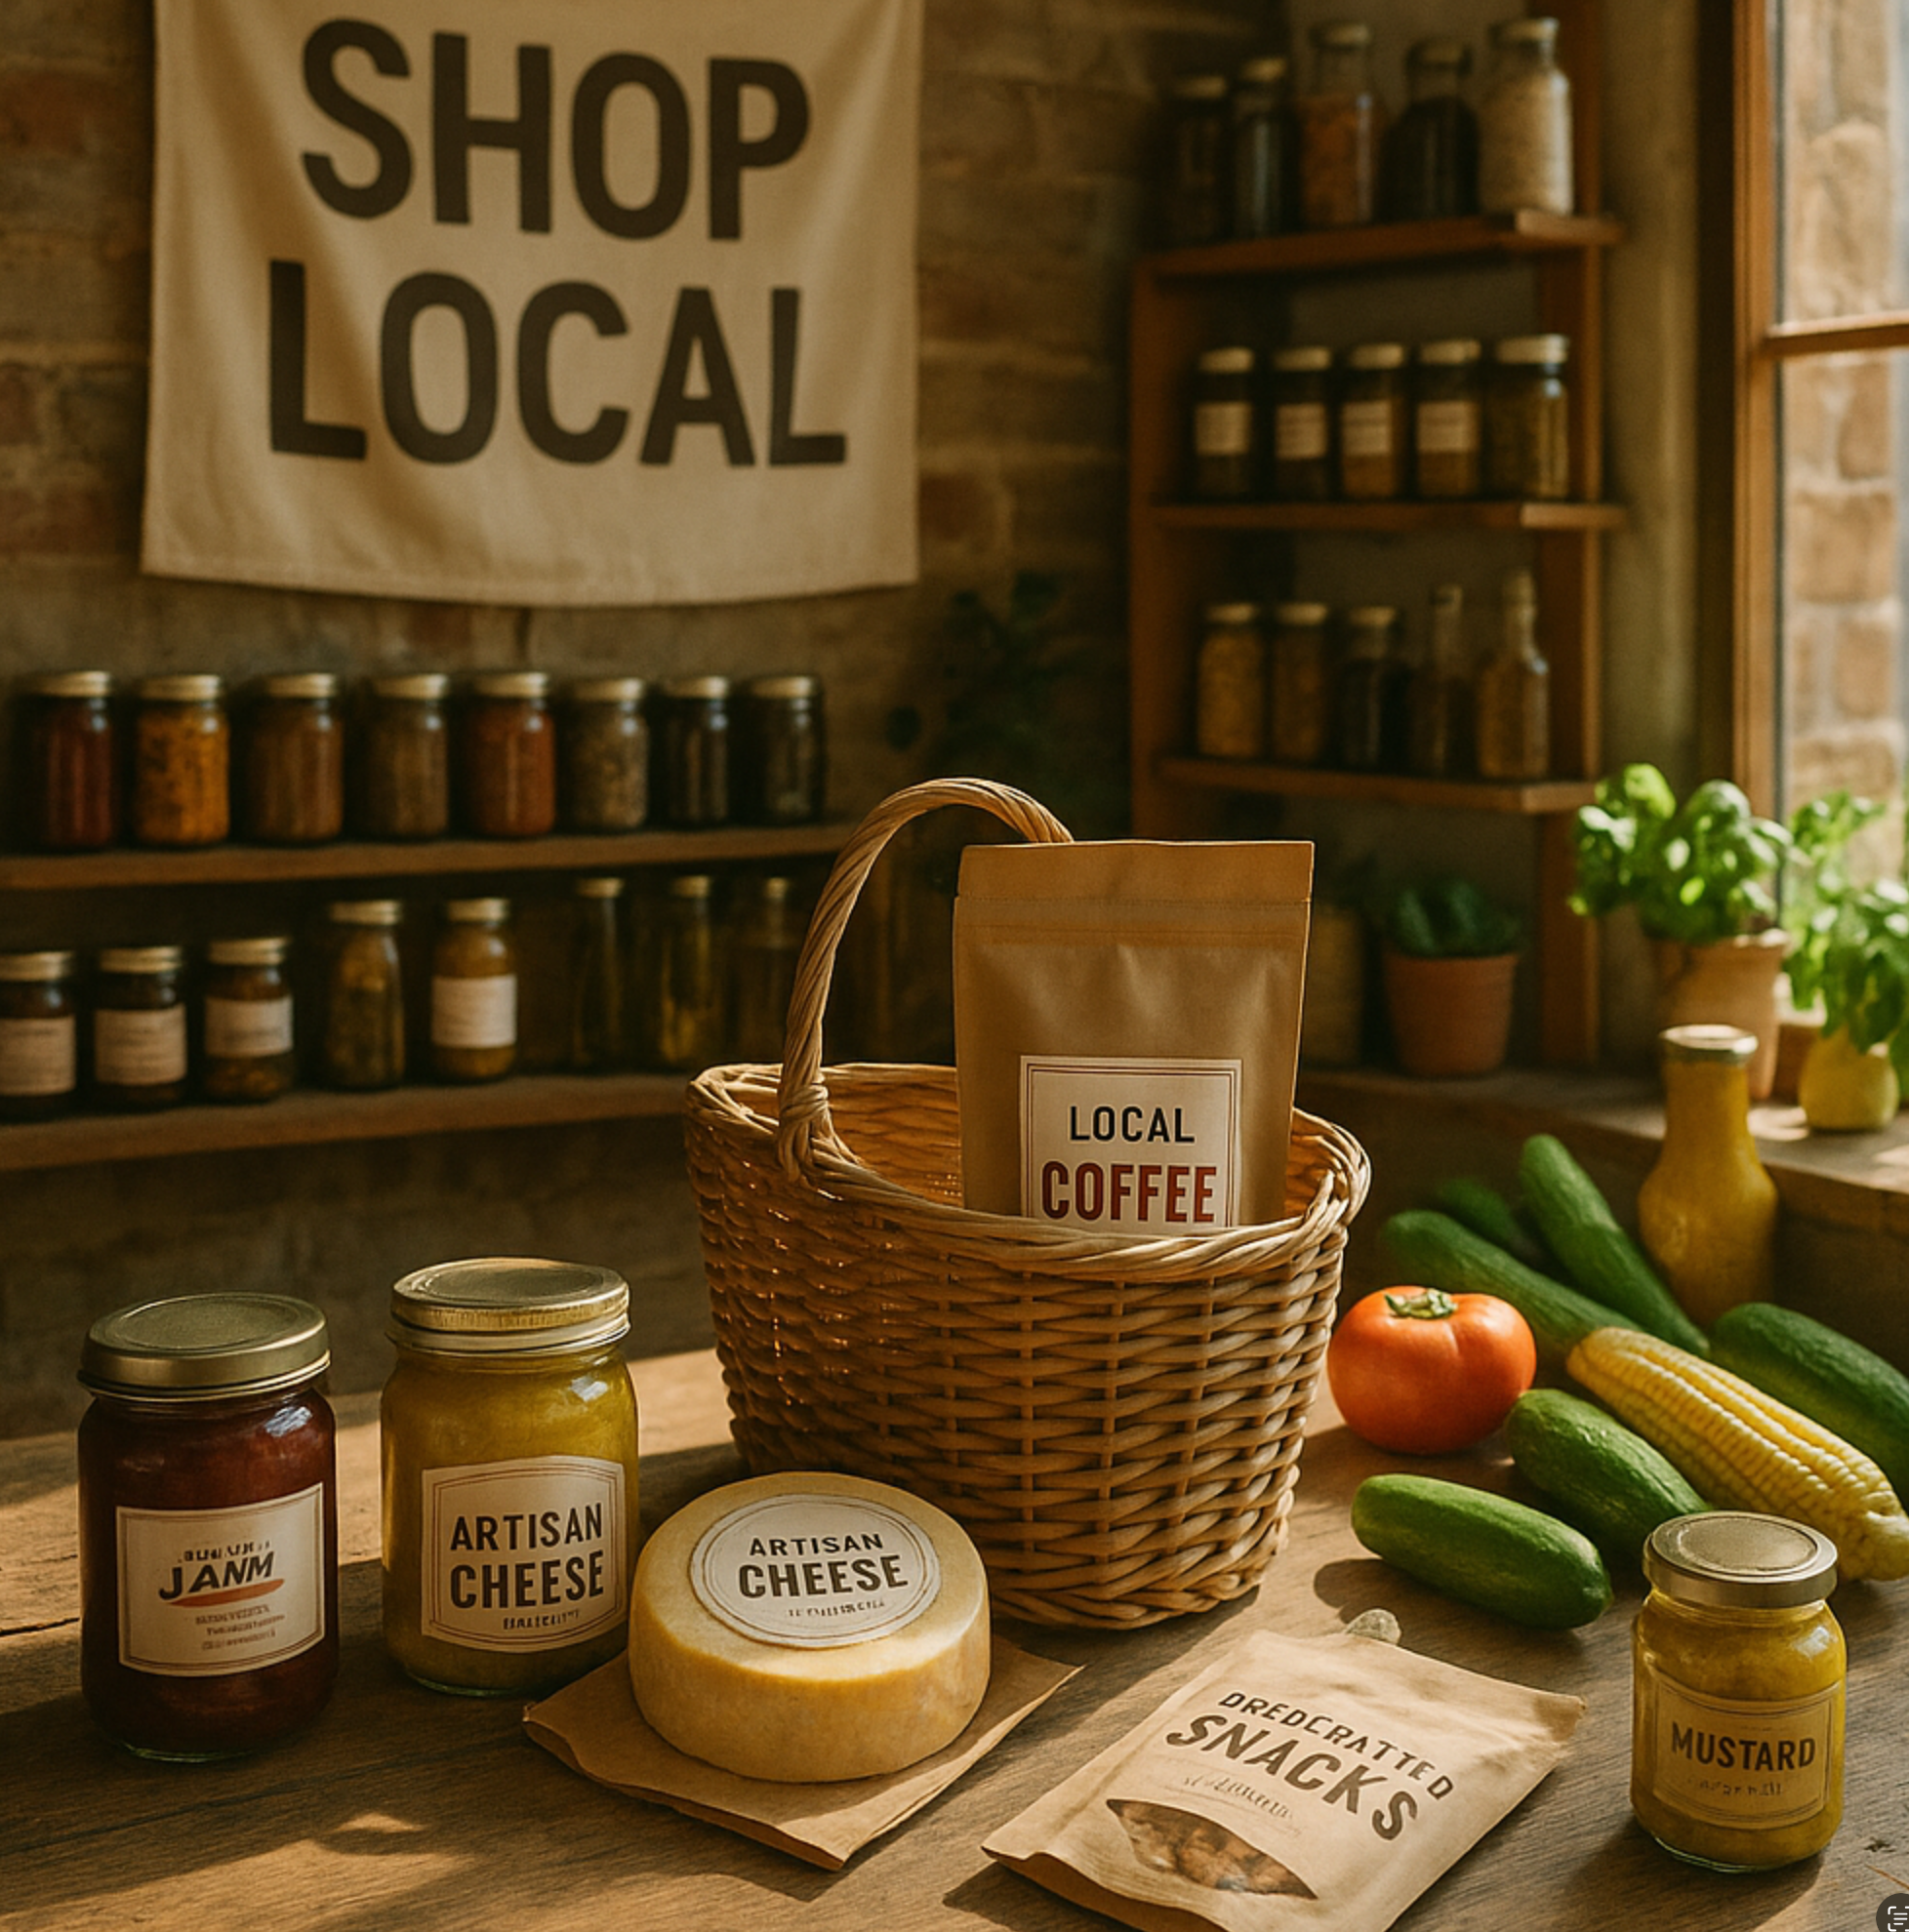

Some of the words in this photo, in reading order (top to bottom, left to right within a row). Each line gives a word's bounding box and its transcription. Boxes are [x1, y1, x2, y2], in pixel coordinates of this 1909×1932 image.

[303, 19, 810, 240] SHOP
[269, 259, 847, 465] LOCAL
[1071, 1106, 1195, 1143] LOCAL
[1041, 1160, 1217, 1223] COFFEE
[450, 1503, 602, 1550] ARTISAN
[749, 1533, 883, 1556] ARTISAN
[450, 1550, 604, 1609] CHEESE
[738, 1554, 909, 1598] CHEESE
[1217, 1692, 1454, 1800] DREDCRATTED
[1671, 1720, 1816, 1772] MUSTARD
[1166, 1714, 1419, 1841] SNACKS
